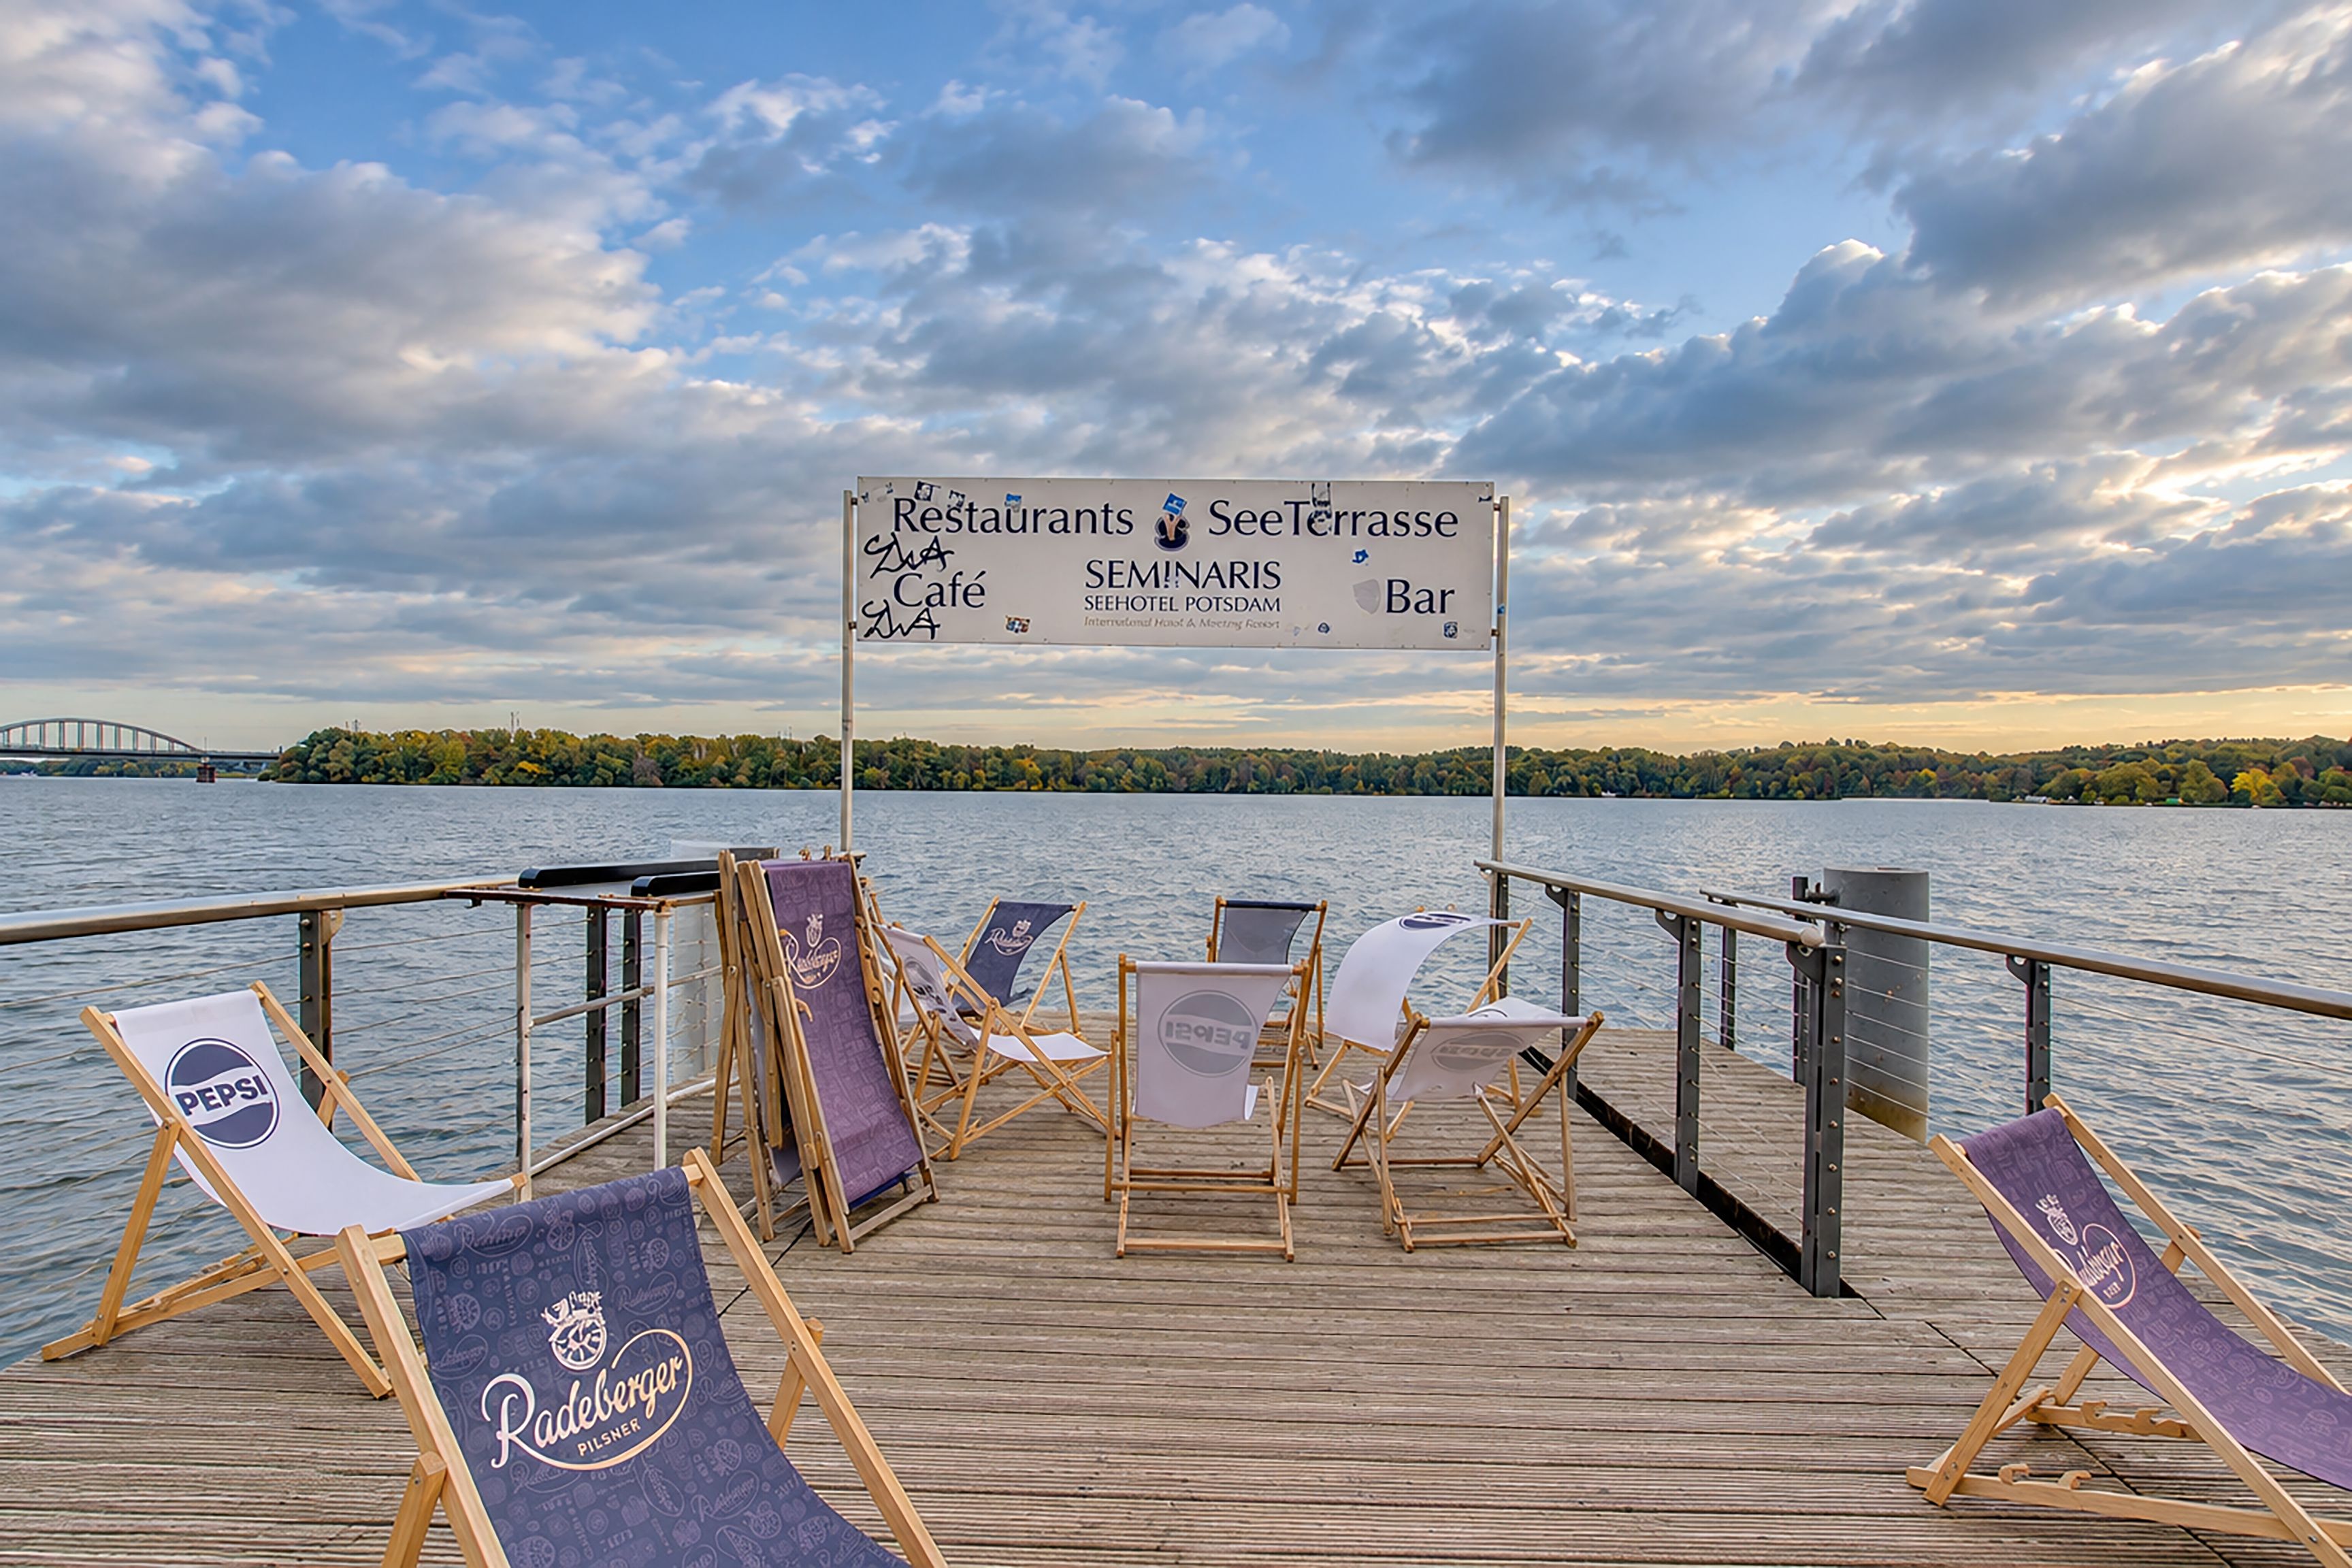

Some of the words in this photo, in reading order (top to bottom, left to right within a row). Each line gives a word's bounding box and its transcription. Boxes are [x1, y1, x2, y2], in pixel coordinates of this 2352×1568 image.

[894, 497, 1134, 535] Restaurants
[894, 570, 986, 608] Café
[1084, 595, 1179, 612] SEEHOTEL
[1186, 595, 1280, 612] POTSDAM
[1385, 578, 1455, 614] Bar
[174, 1075, 268, 1117] PEPSI
[480, 1354, 685, 1469] Radeberger
[577, 1418, 641, 1456] PILSNER
